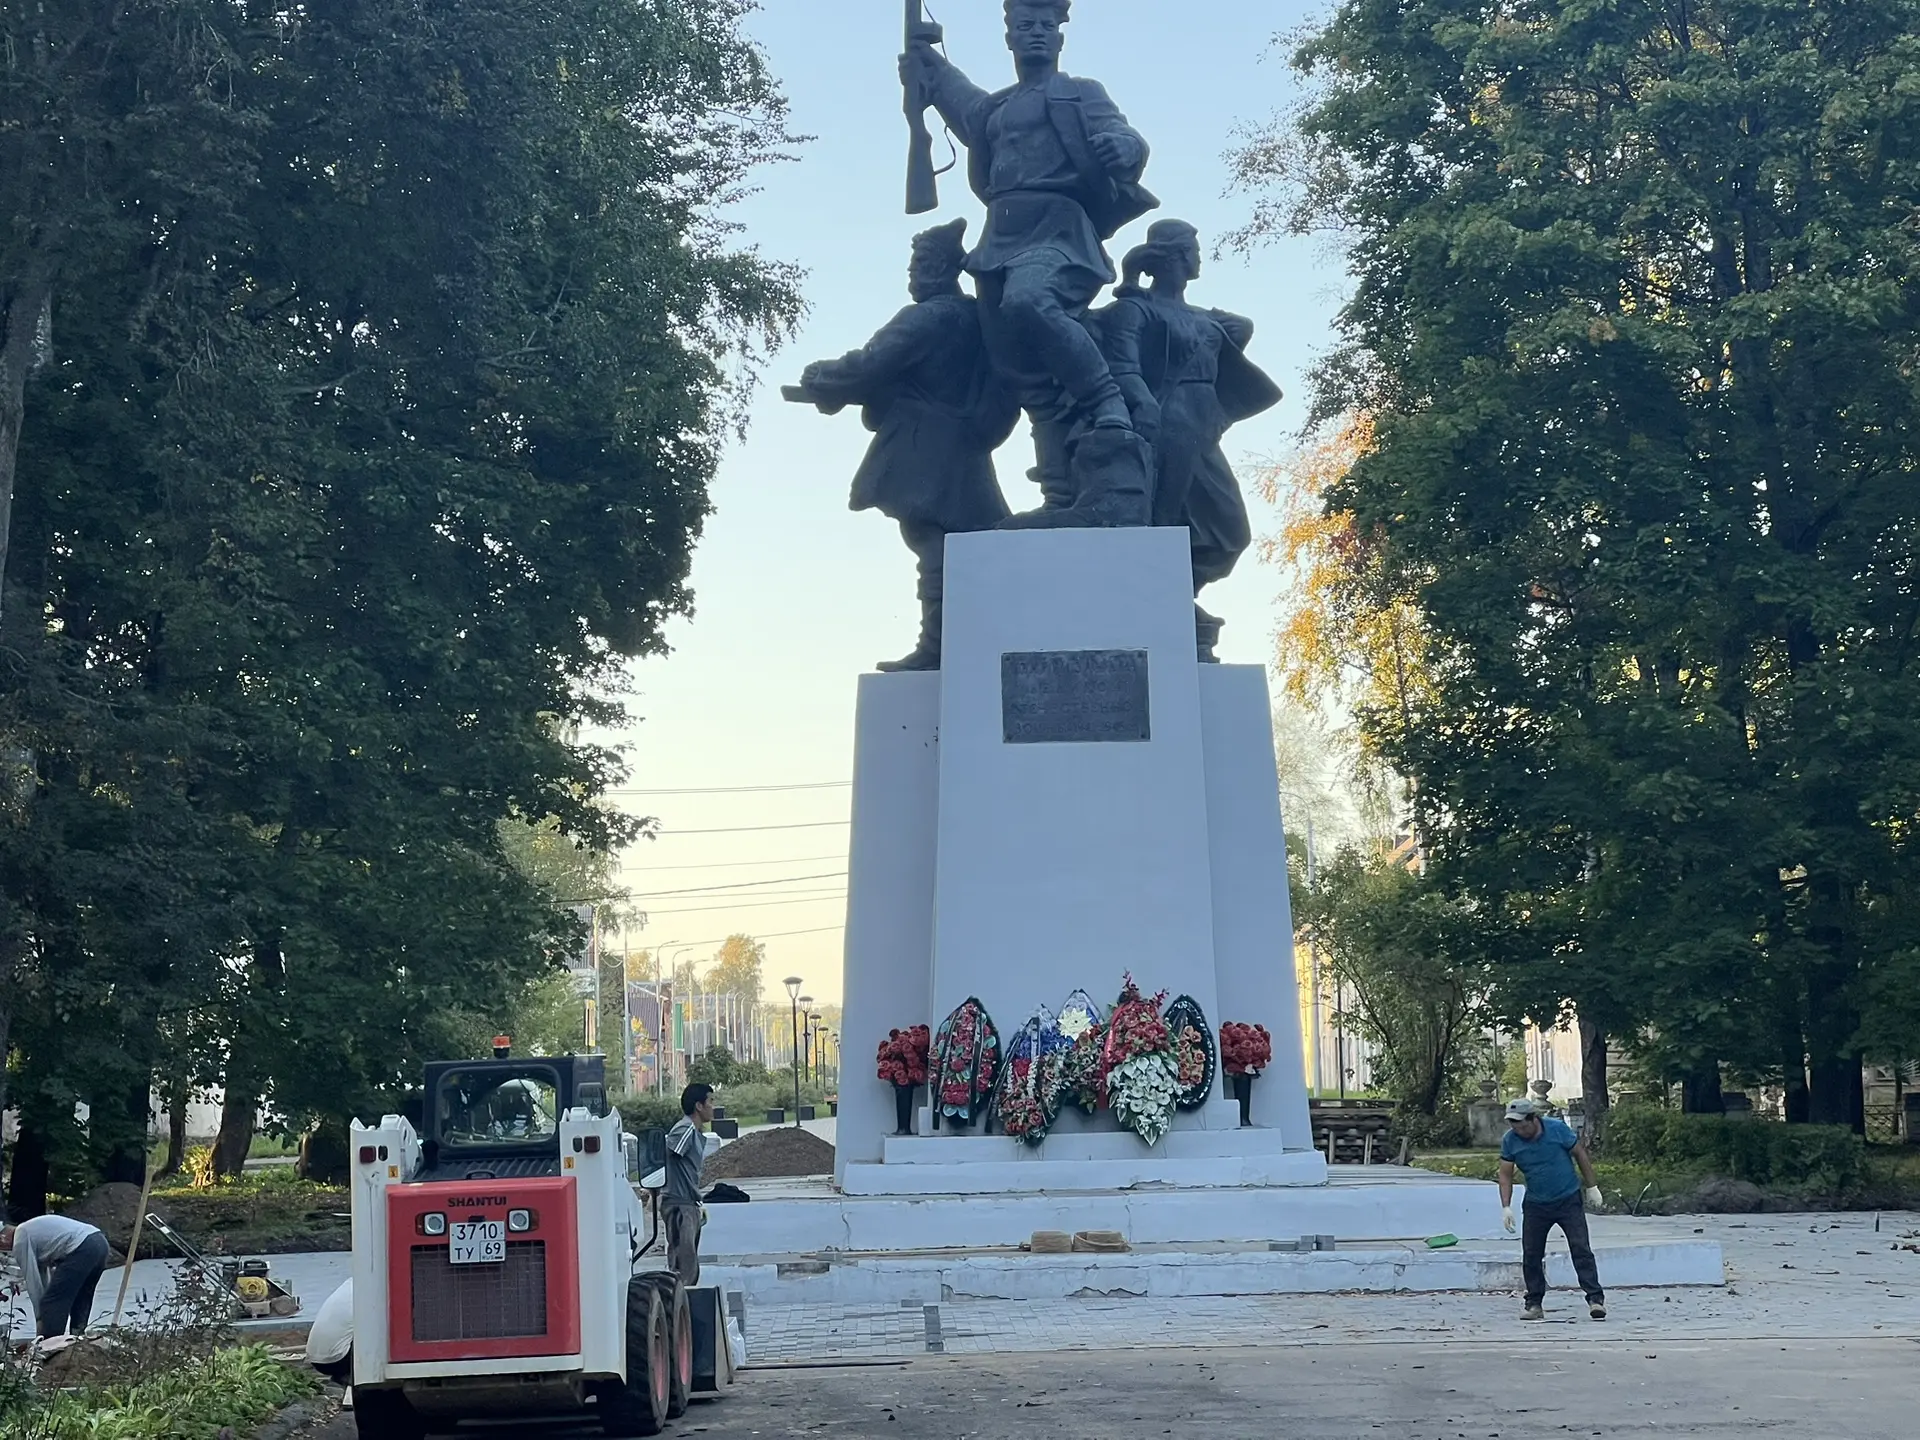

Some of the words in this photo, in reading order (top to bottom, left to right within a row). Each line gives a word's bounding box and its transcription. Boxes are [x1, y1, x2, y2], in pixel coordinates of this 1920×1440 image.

[448, 1196, 506, 1207] SHANTUI
[457, 1223, 497, 1240] 3710
[485, 1242, 501, 1255] 69
